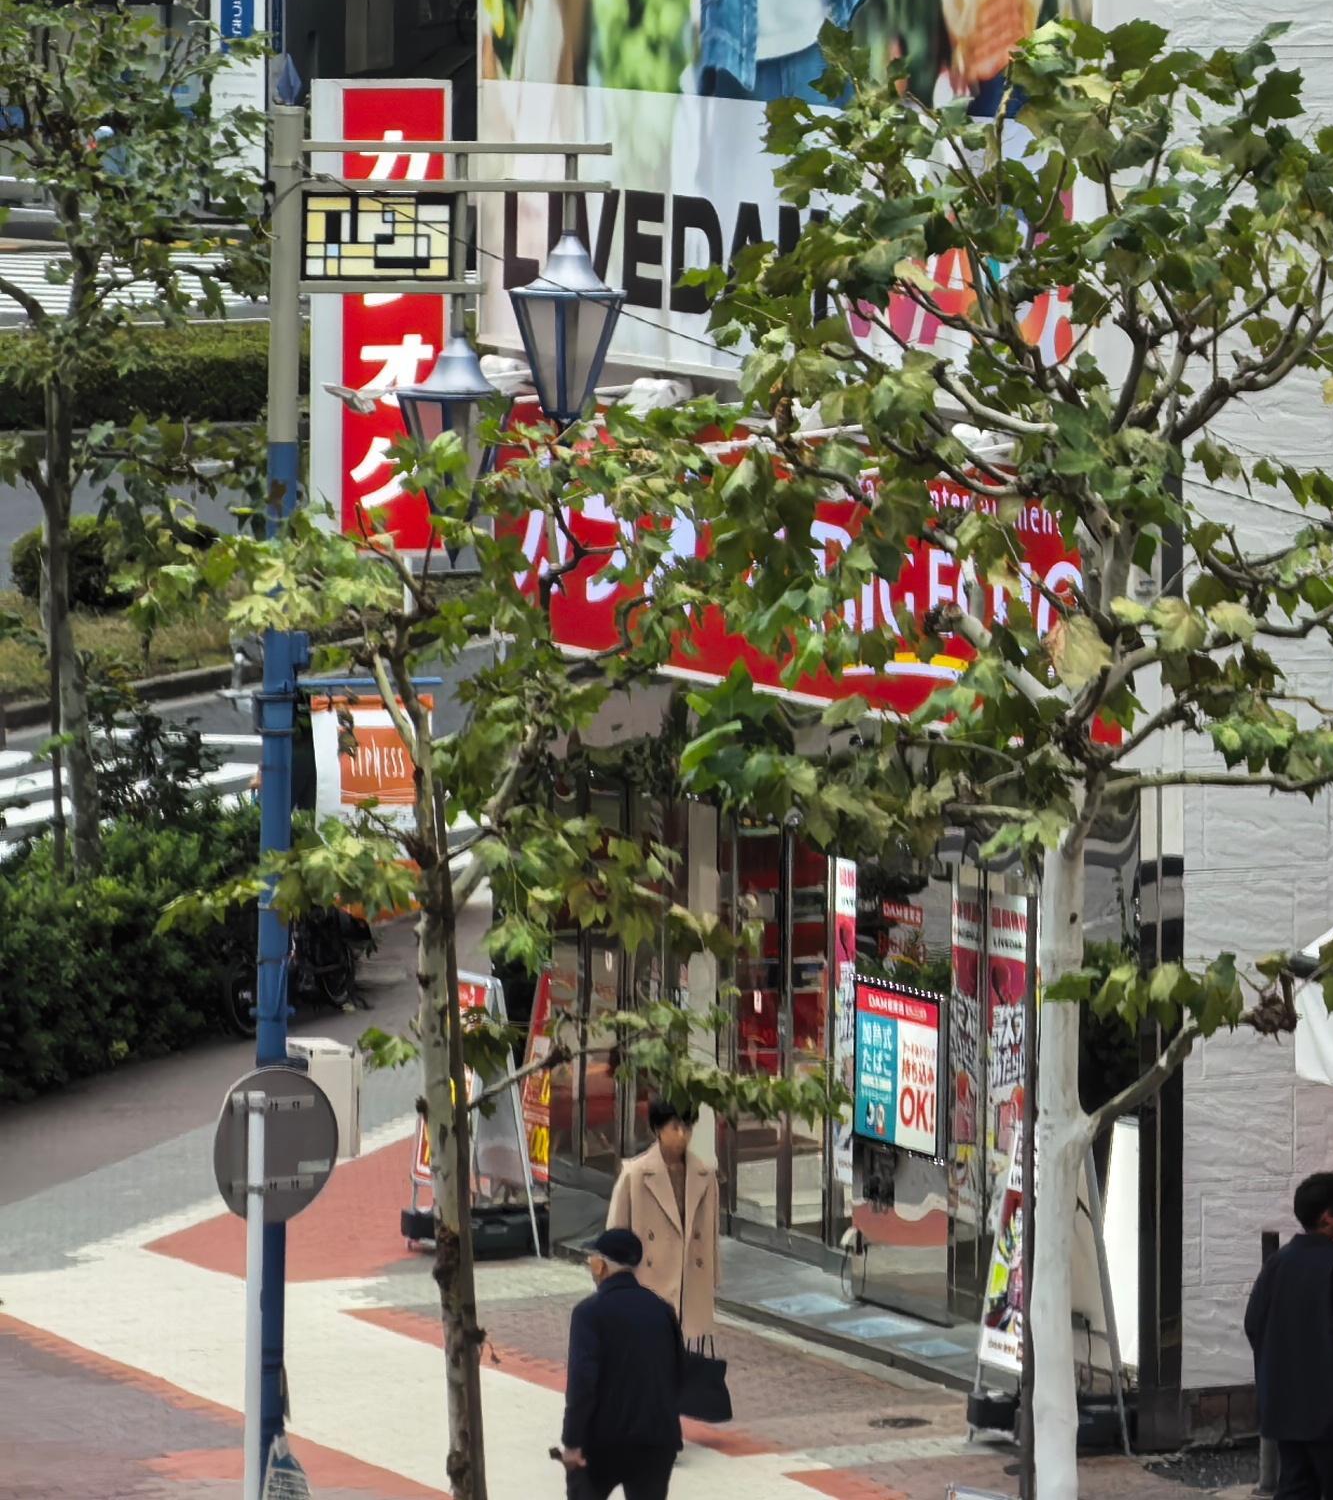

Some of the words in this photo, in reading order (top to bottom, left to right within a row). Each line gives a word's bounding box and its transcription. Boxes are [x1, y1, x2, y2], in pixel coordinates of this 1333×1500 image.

[350, 130, 434, 508] カオケ
[900, 1086, 935, 1134] OK!
